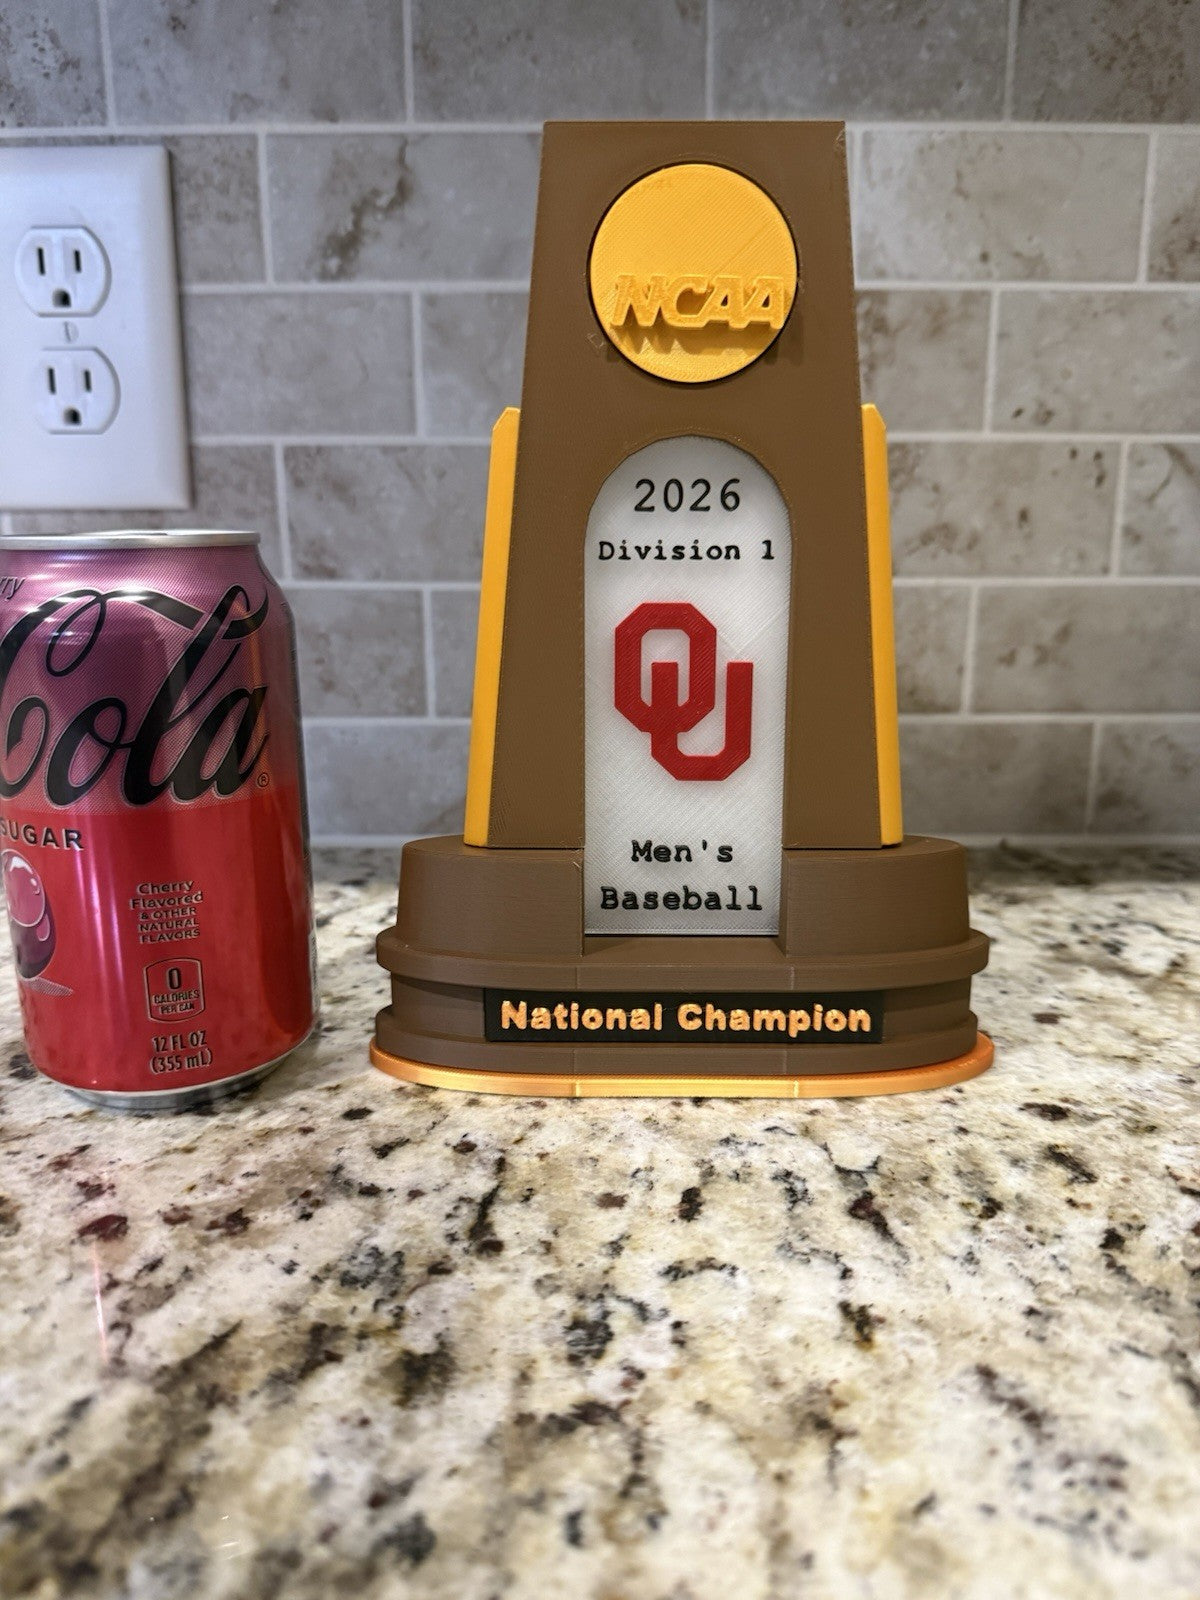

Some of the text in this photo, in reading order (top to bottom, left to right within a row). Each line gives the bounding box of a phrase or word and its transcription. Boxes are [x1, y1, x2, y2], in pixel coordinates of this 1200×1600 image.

[610, 273, 786, 330] NCAA
[633, 478, 741, 513] 2026
[598, 539, 775, 561] Division 1
[614, 602, 754, 781] OU
[0, 816, 84, 850] SUGAR
[630, 839, 734, 863] Men's
[137, 880, 194, 895] Cherry
[600, 886, 763, 911] Baseball
[130, 890, 204, 909] Flavored
[138, 917, 199, 933] NATURAL
[139, 906, 197, 921] & OTHER
[139, 928, 200, 944] FLAVORS
[167, 967, 182, 990] 0
[153, 989, 200, 1005] CALORIES
[160, 1002, 194, 1015] PER CAN
[501, 1000, 871, 1038] National Champion
[152, 1030, 207, 1053] 12 FL OZ
[150, 1047, 213, 1075] (355 mL)
